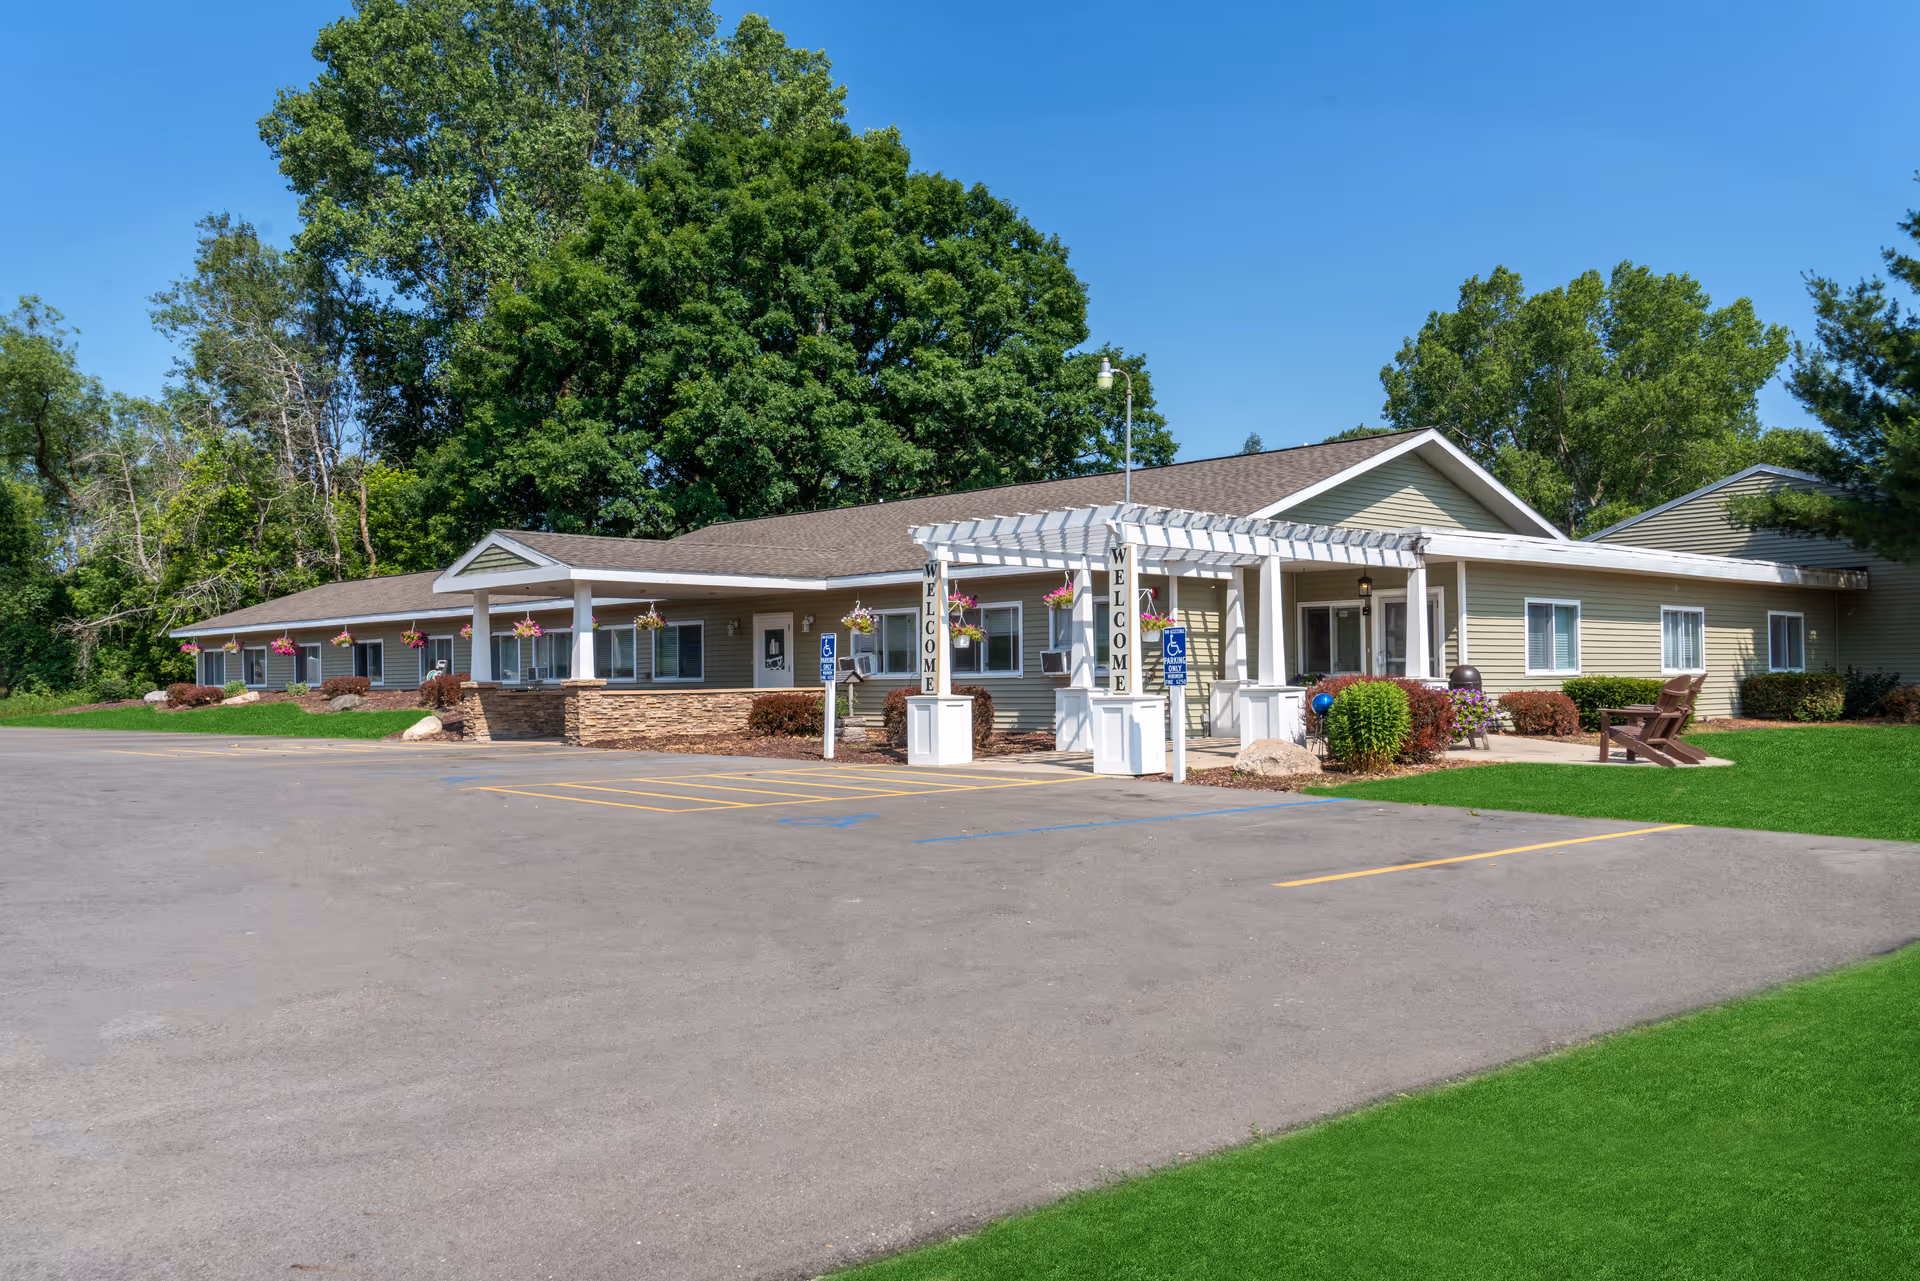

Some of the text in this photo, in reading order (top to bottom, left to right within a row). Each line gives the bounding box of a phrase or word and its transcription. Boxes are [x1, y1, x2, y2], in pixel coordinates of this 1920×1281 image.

[924, 563, 937, 692] WELCOME
[1111, 547, 1128, 692] WELCOME
[1164, 656, 1186, 665] PARKING
